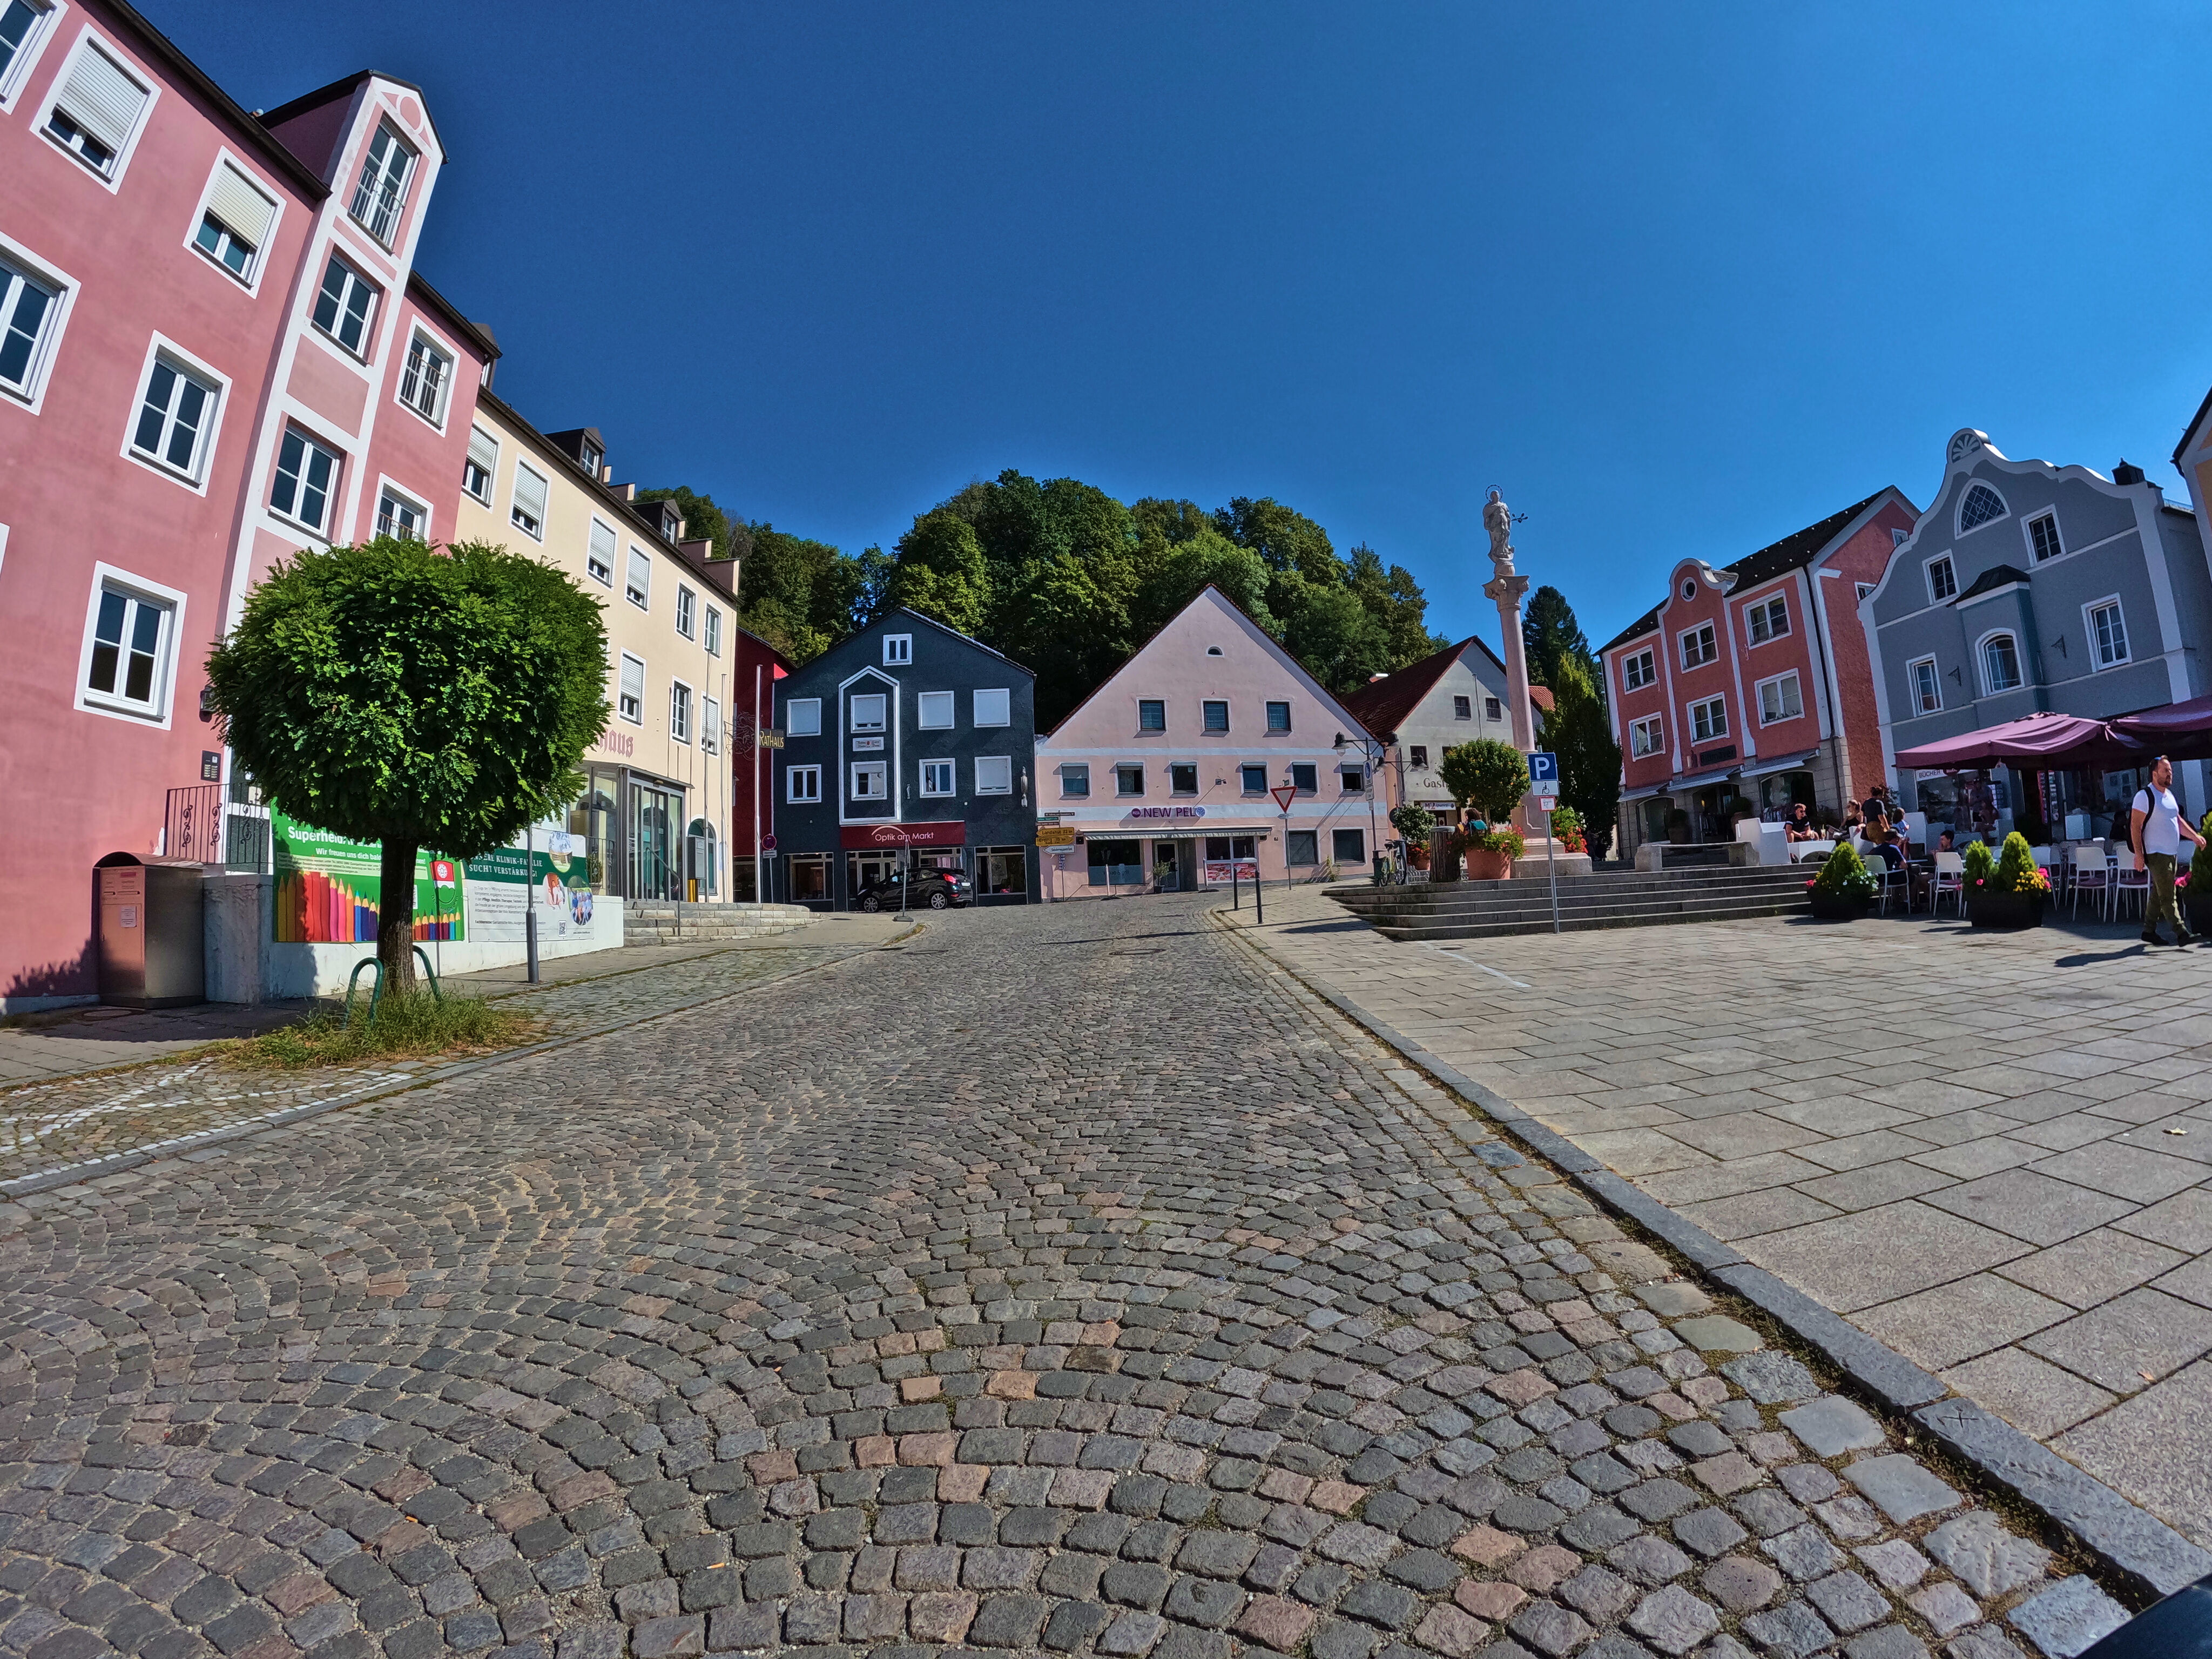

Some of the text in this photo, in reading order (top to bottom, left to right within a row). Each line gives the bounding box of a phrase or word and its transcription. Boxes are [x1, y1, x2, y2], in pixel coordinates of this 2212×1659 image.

[759, 730, 784, 747] RATHAUS
[1535, 757, 1550, 779] P
[1143, 807, 1172, 818] NEW
[875, 832, 934, 844] Optik am Markt
[329, 848, 346, 857] freuen
[496, 855, 543, 867] KLINIK-FALIE
[469, 864, 538, 877] SUCHT VERSTÄRKUG!
